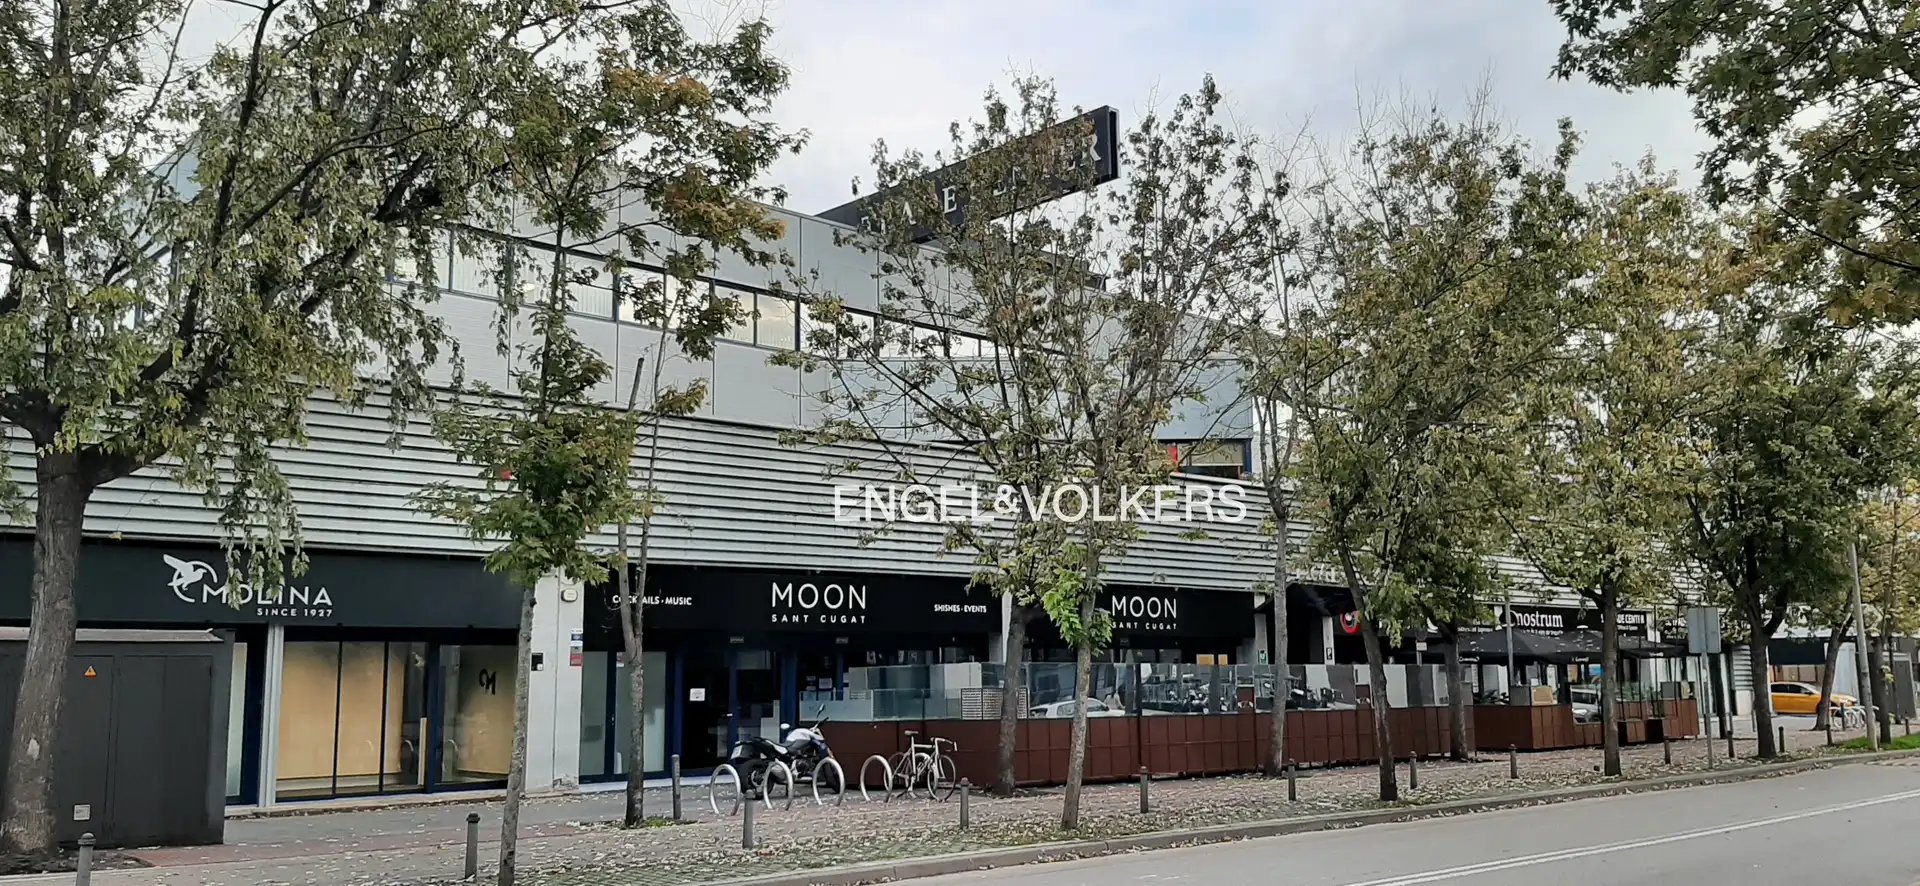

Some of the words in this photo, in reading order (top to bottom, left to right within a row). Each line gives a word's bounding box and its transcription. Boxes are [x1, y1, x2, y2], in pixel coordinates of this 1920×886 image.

[612, 594, 660, 605] CKAILS
[664, 596, 692, 606] MUSIC
[771, 582, 866, 610] MOON
[257, 607, 297, 617] SINCE
[304, 608, 333, 617] 1927
[1112, 595, 1177, 619] MOON
[771, 613, 809, 623] SANT
[820, 614, 866, 624] CUGAT
[1516, 610, 1564, 628] nostrum
[1145, 622, 1177, 630] CUGAT
